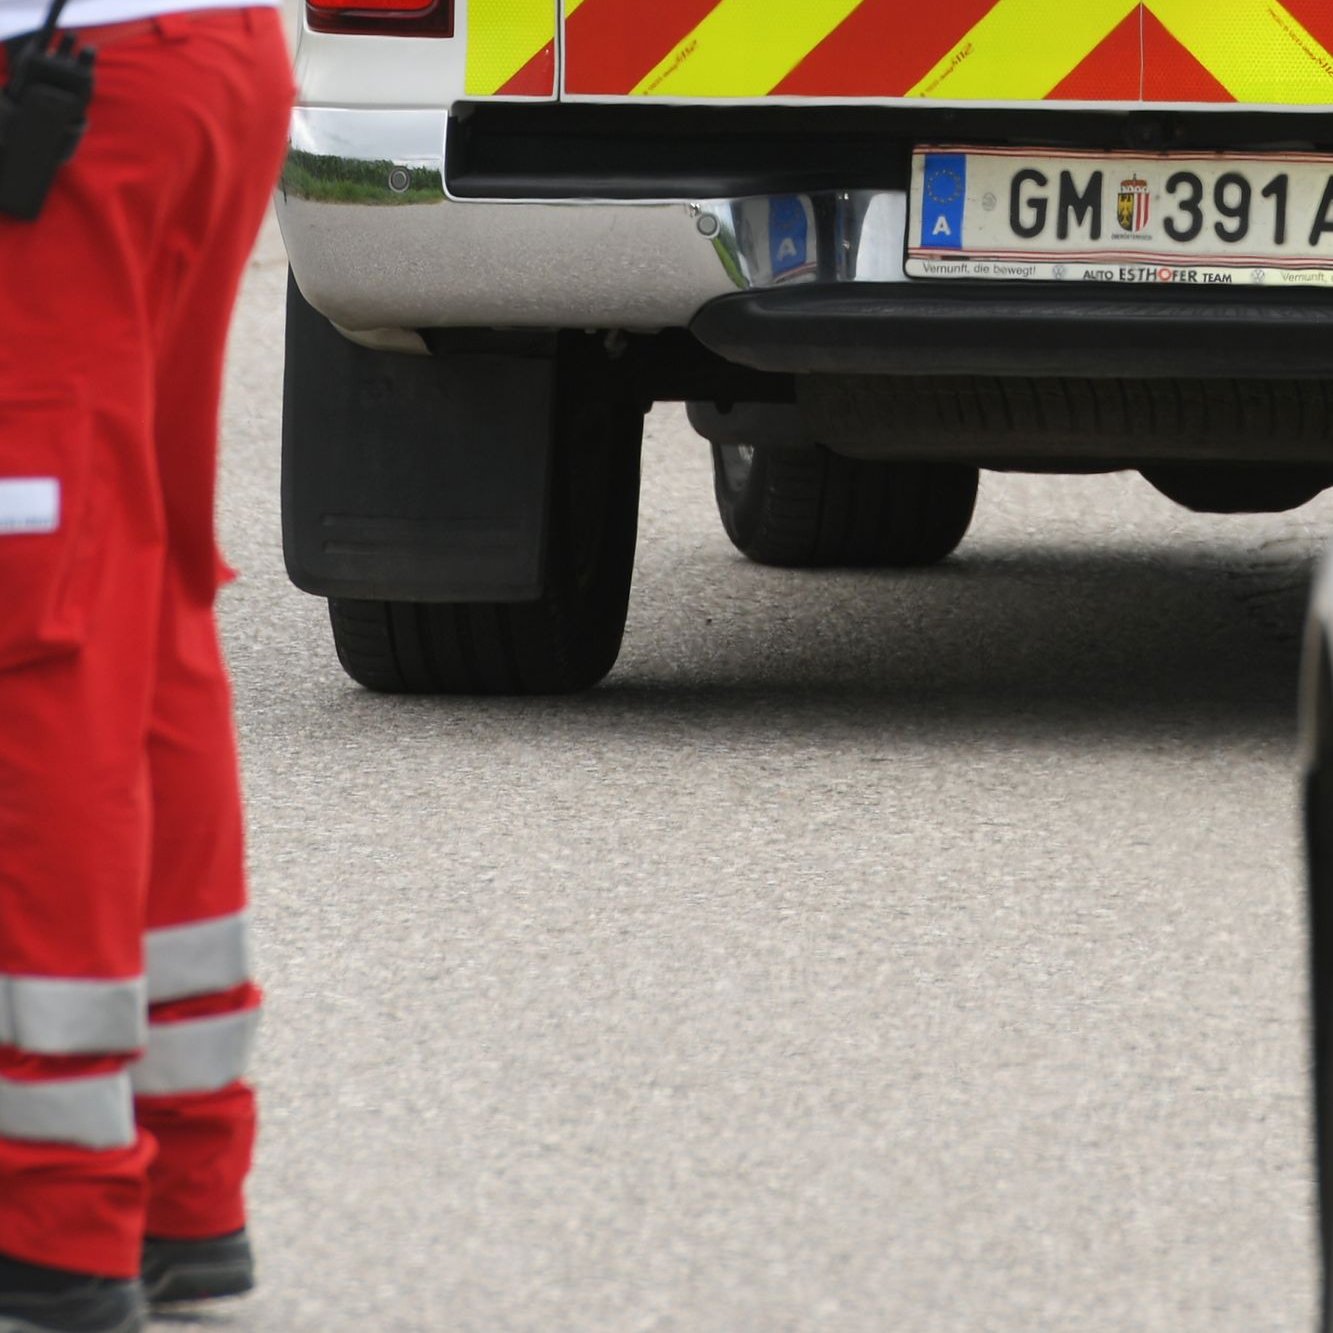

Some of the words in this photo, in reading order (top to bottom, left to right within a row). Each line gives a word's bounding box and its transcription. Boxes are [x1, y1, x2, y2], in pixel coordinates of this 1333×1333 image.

[1009, 168, 1103, 241] GM
[931, 216, 951, 236] A
[973, 264, 990, 274] die
[1082, 269, 1114, 281] AUTO
[1119, 267, 1198, 283] ESTHOFER
[1202, 273, 1233, 284] TEAM
